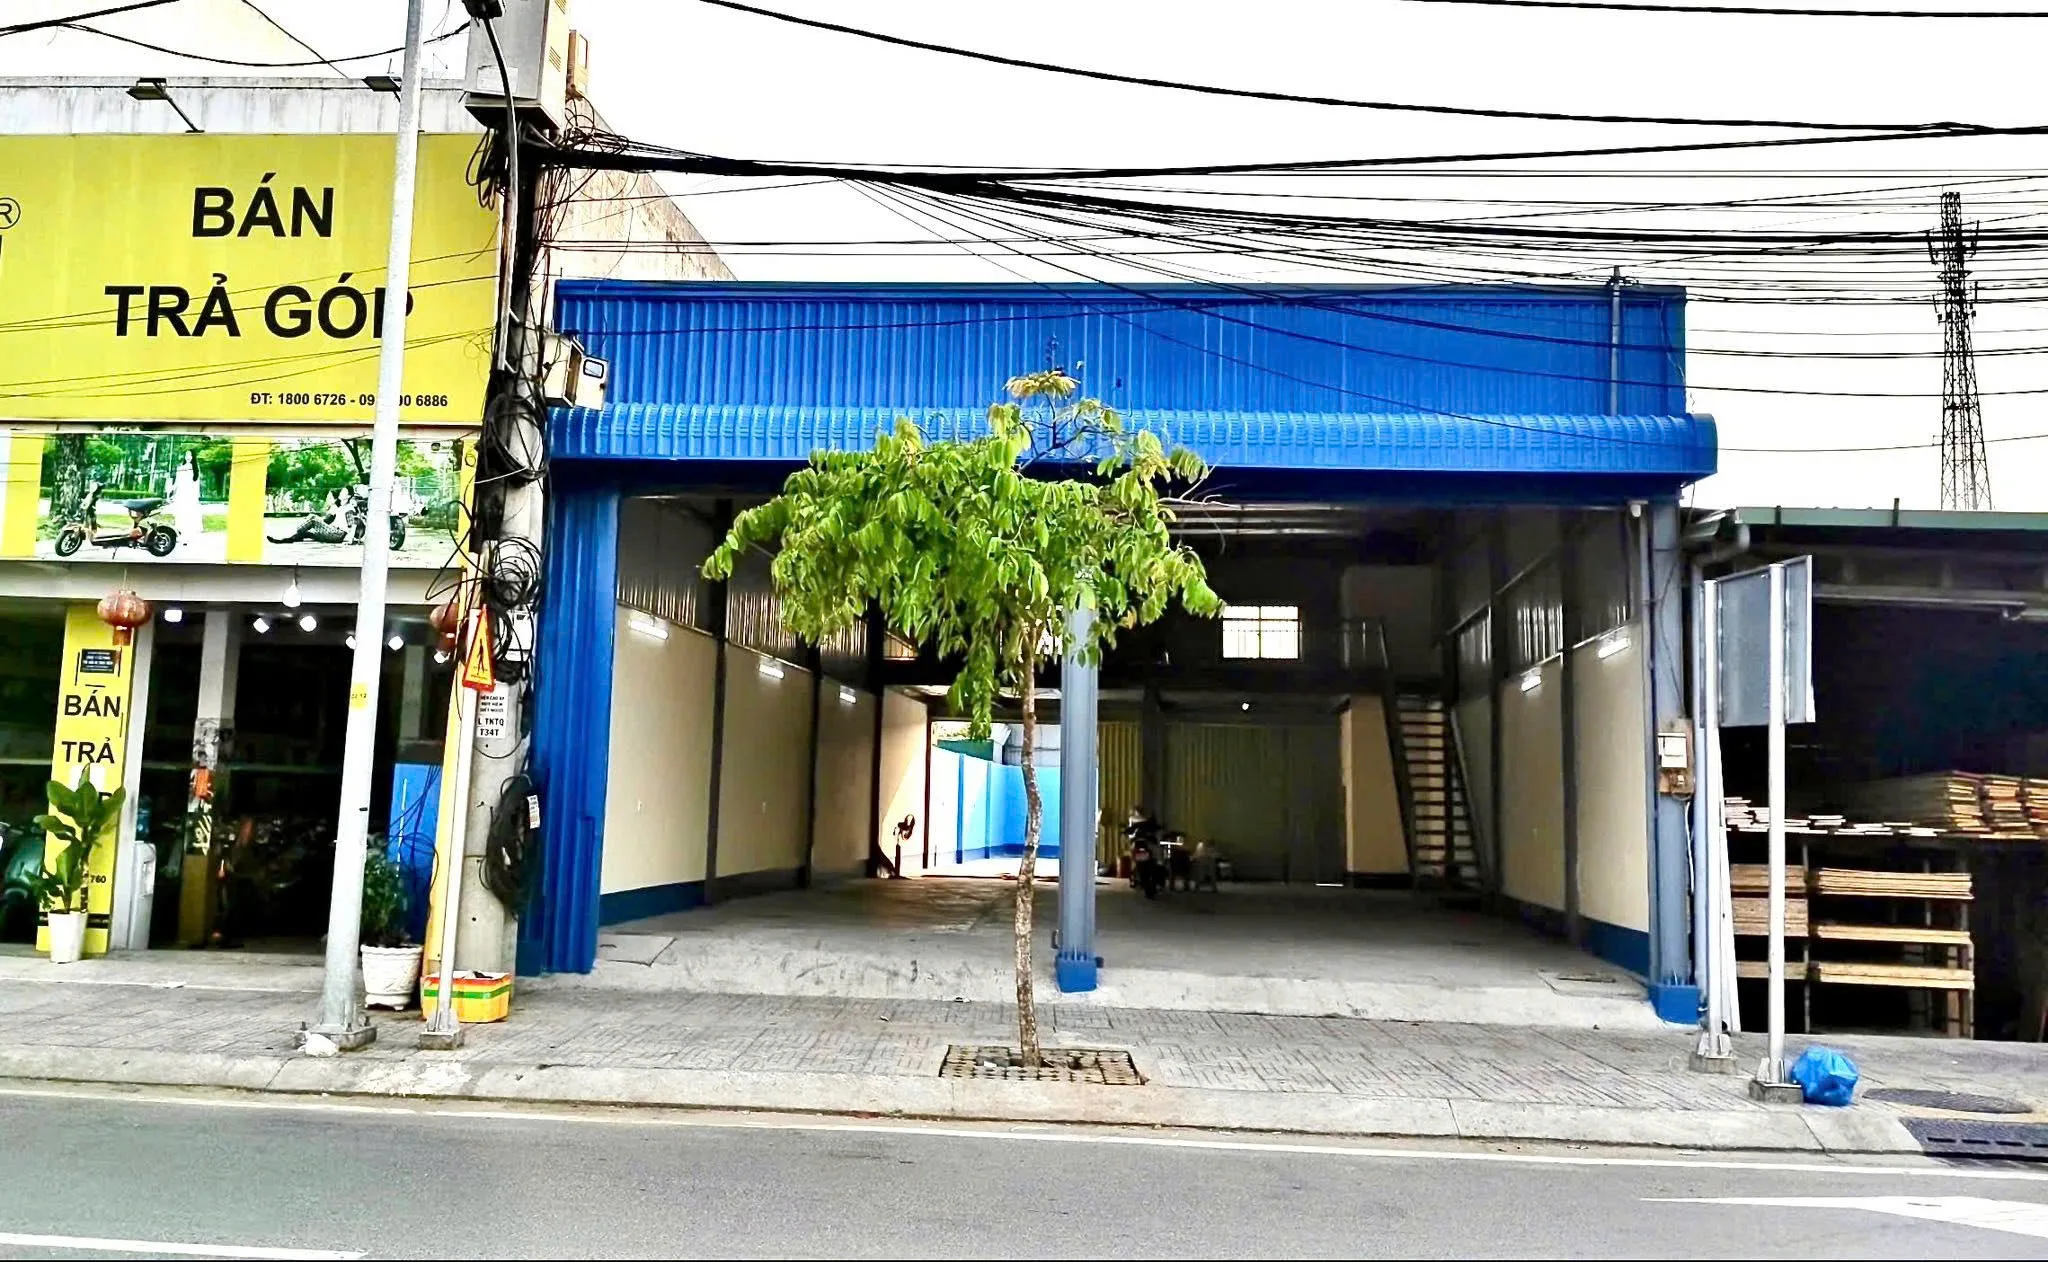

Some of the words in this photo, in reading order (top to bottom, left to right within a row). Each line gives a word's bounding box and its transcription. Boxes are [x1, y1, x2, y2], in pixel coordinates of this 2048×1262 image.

[192, 172, 334, 237] BÁN
[104, 273, 241, 337] TRẢ
[250, 392, 273, 405] ĐT:
[277, 393, 310, 405] 1800
[314, 394, 346, 406] 6726
[415, 395, 448, 407] 6886
[64, 690, 121, 718] BÁN
[61, 737, 115, 764] TRẢ
